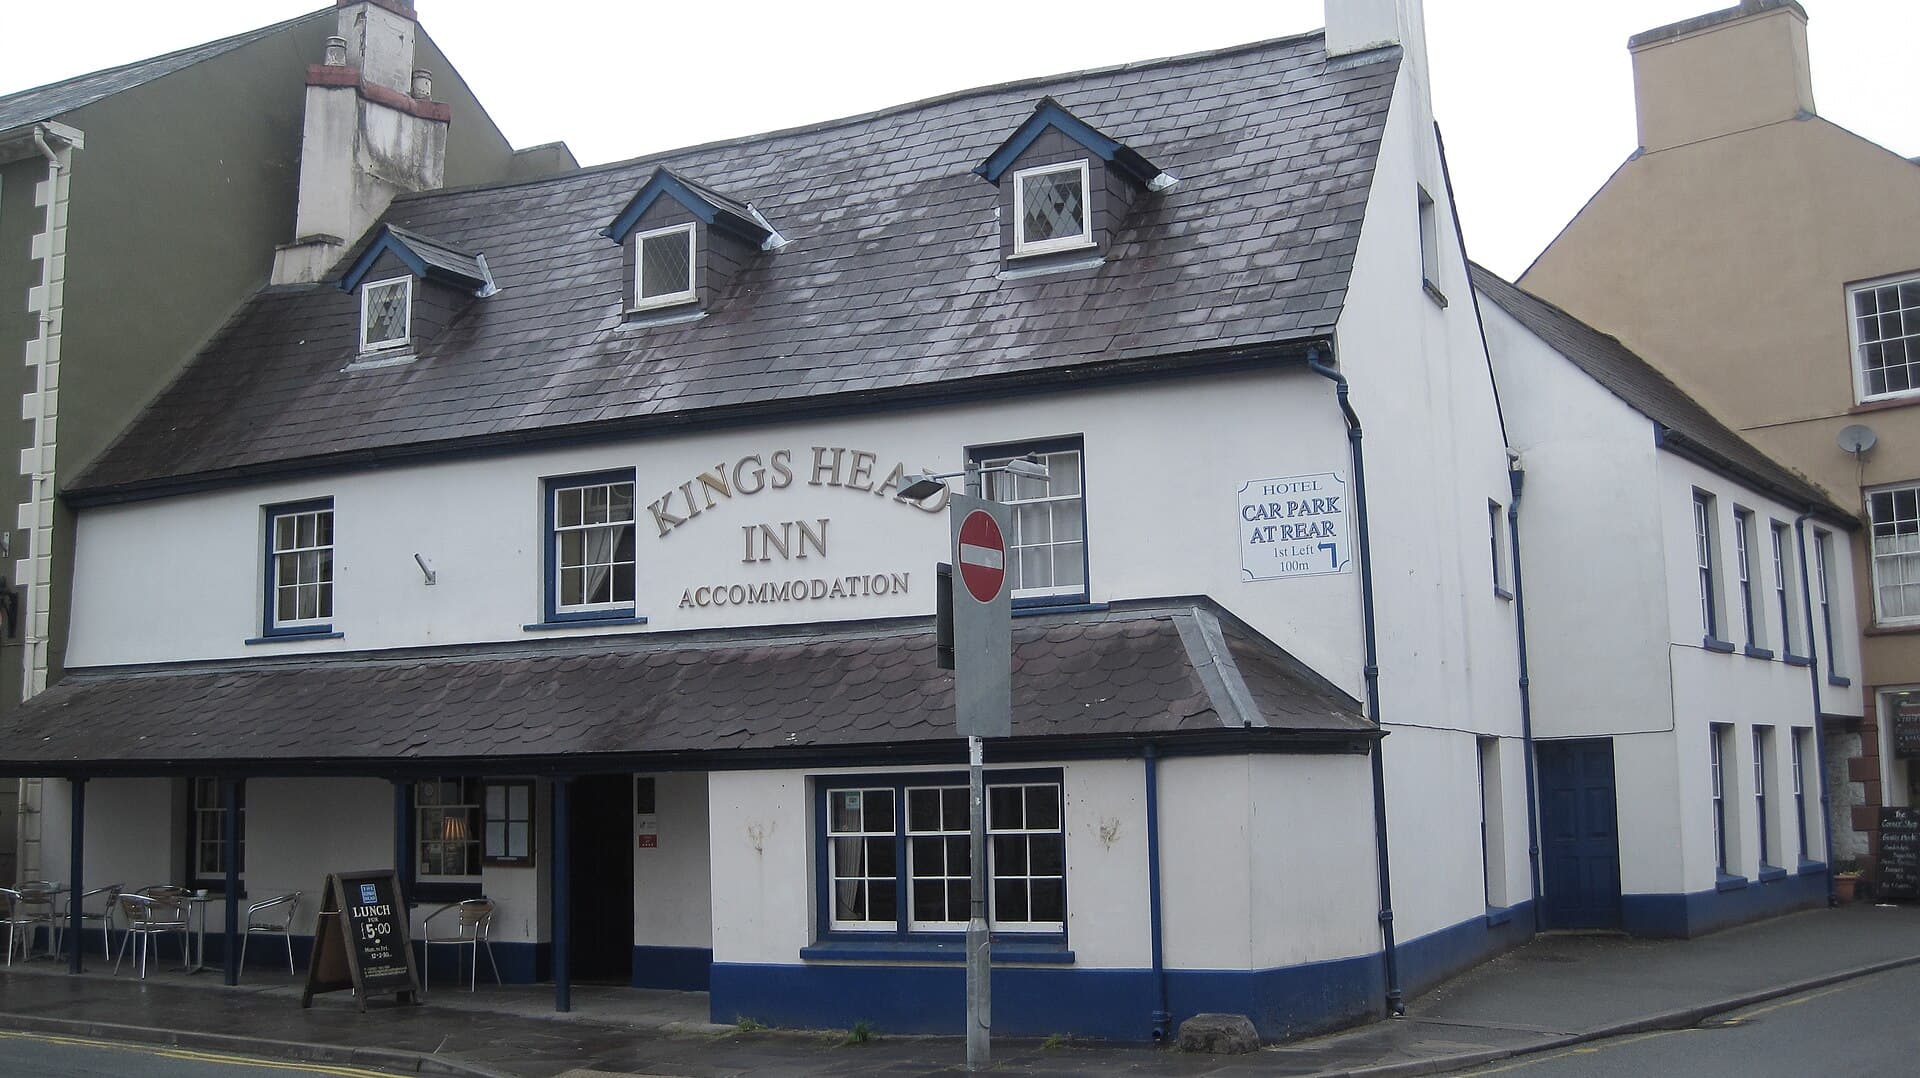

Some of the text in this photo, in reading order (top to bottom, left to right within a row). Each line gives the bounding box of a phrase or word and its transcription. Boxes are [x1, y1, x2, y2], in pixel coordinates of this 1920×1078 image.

[646, 446, 950, 538] KINGS HEAD
[1263, 480, 1322, 495] HOTEL
[1242, 497, 1341, 521] CAR PARK
[741, 518, 829, 563] INN
[1250, 520, 1337, 544] AT REAR
[1274, 544, 1314, 558] 1st Left
[1280, 561, 1309, 572] 100m
[678, 571, 910, 609] ACCOMMODATION
[352, 904, 391, 917] LUNCH
